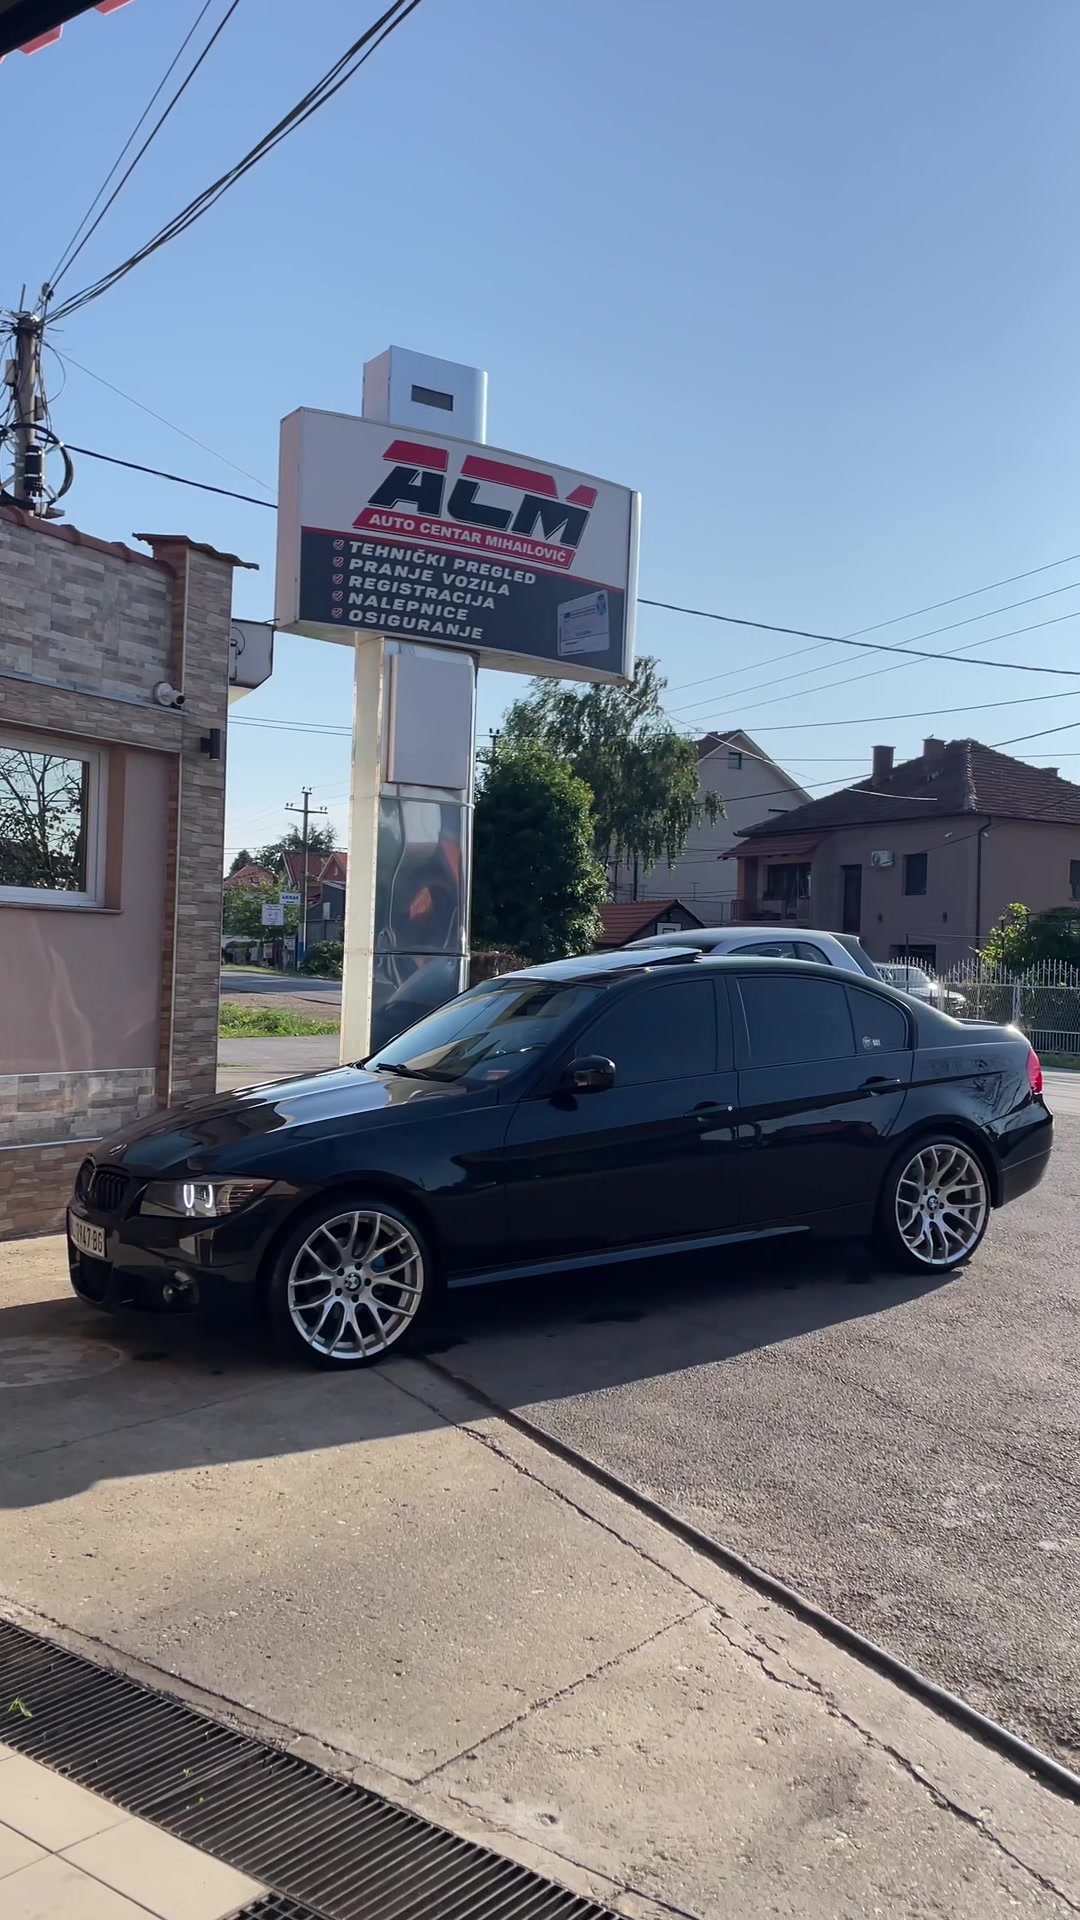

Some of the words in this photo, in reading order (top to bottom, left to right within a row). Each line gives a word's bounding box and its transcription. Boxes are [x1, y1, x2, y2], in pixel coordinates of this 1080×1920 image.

[369, 514, 415, 531] AUTO
[419, 522, 481, 544] CENTAR
[485, 535, 566, 562] MIHAILOVIĆ
[348, 558, 434, 582] PRANJE
[442, 572, 510, 596] VOZILA
[349, 541, 447, 567] TEHNIČKI
[453, 558, 536, 584] PREGLED
[348, 575, 495, 609] REGISTRACIJA
[348, 592, 469, 621] NALEPNICE
[348, 609, 483, 640] OSIGURANJE
